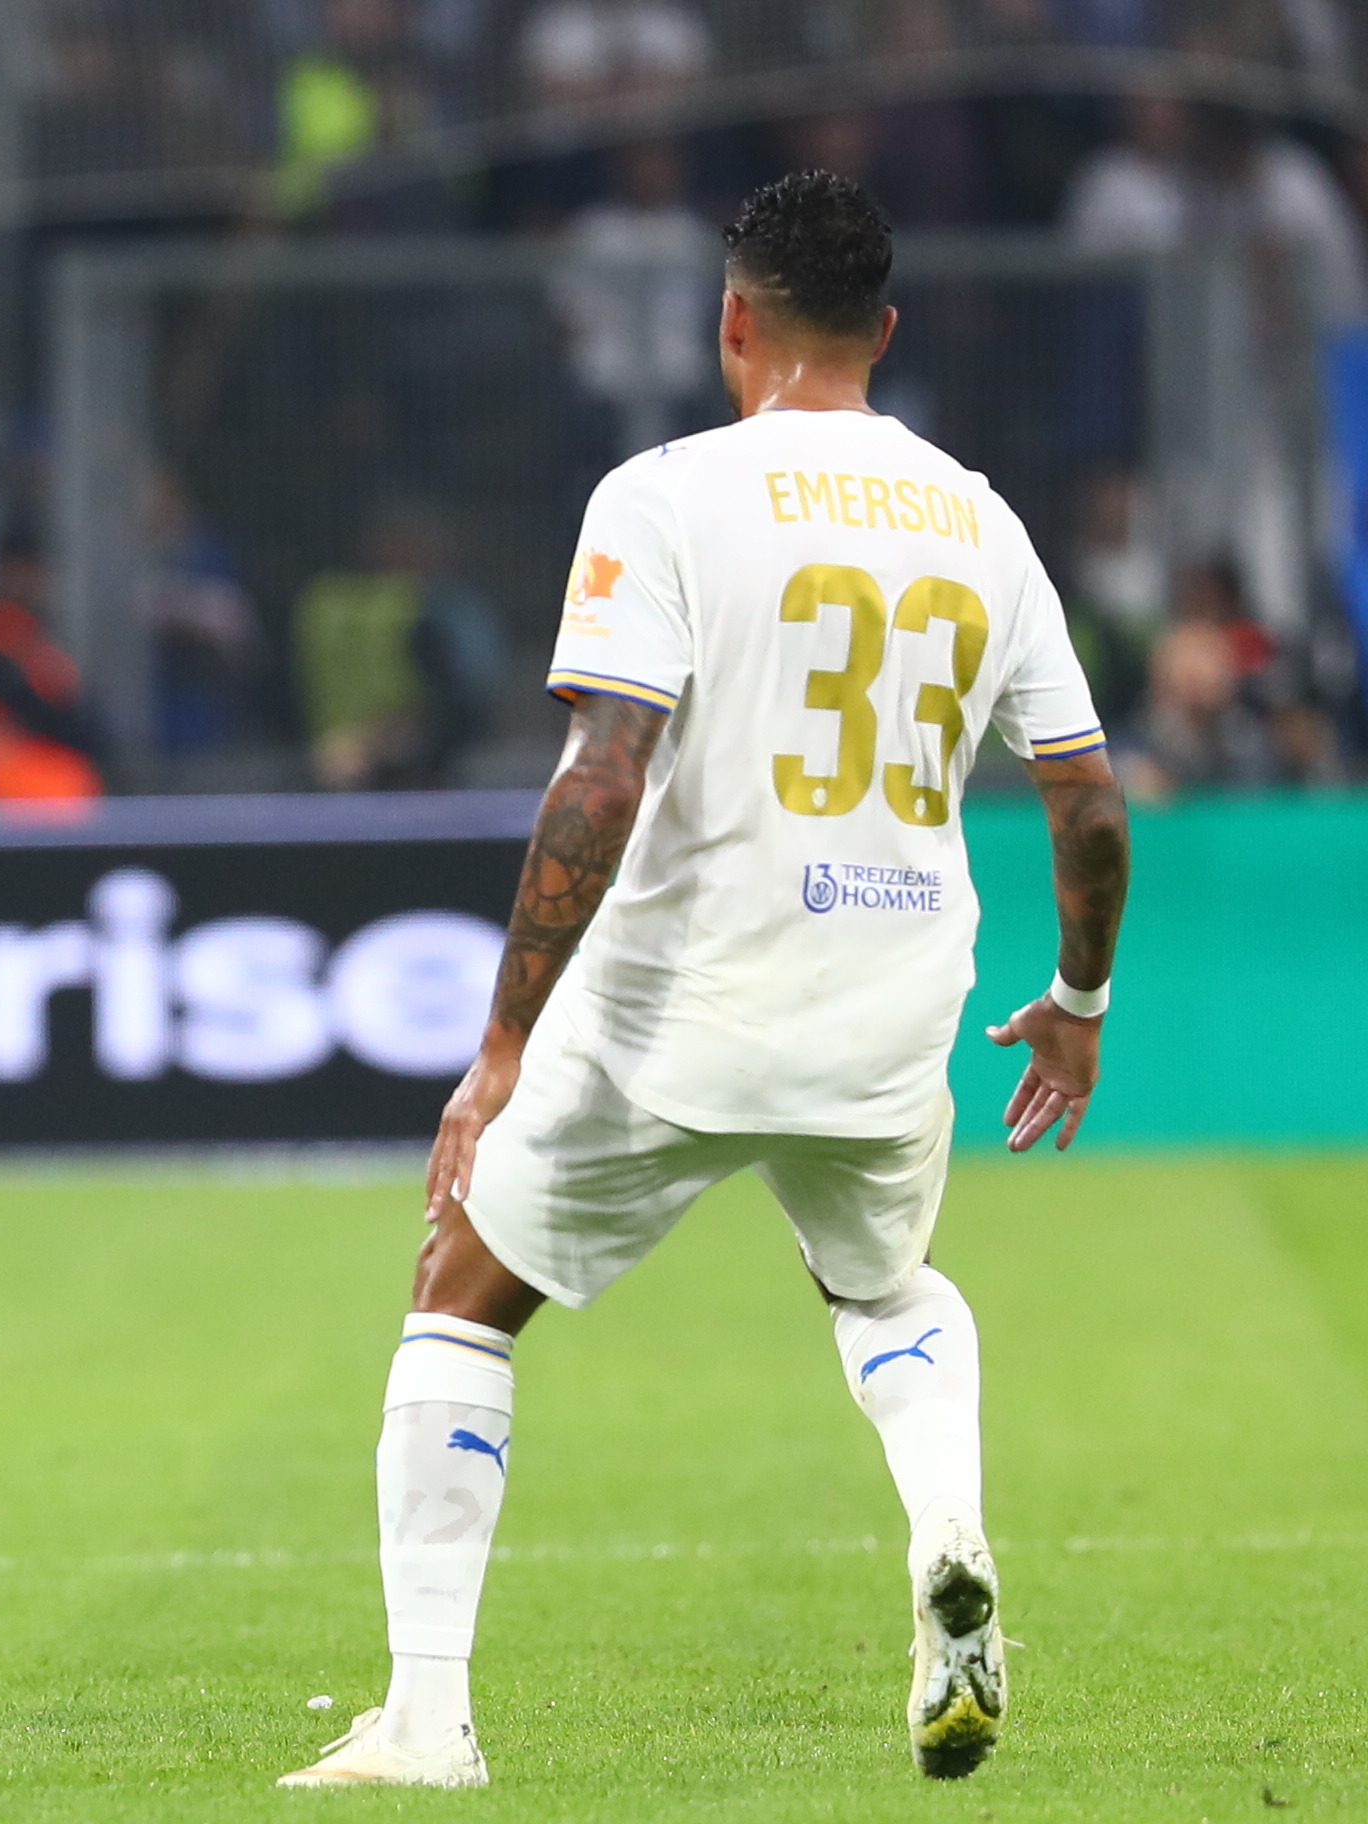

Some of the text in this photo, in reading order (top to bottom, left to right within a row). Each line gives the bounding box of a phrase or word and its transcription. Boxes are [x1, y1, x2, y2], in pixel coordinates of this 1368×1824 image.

[764, 470, 980, 549] EMERSON
[773, 563, 989, 827] 33
[840, 863, 942, 887] TREIZIÈME
[841, 884, 942, 912] HOMME
